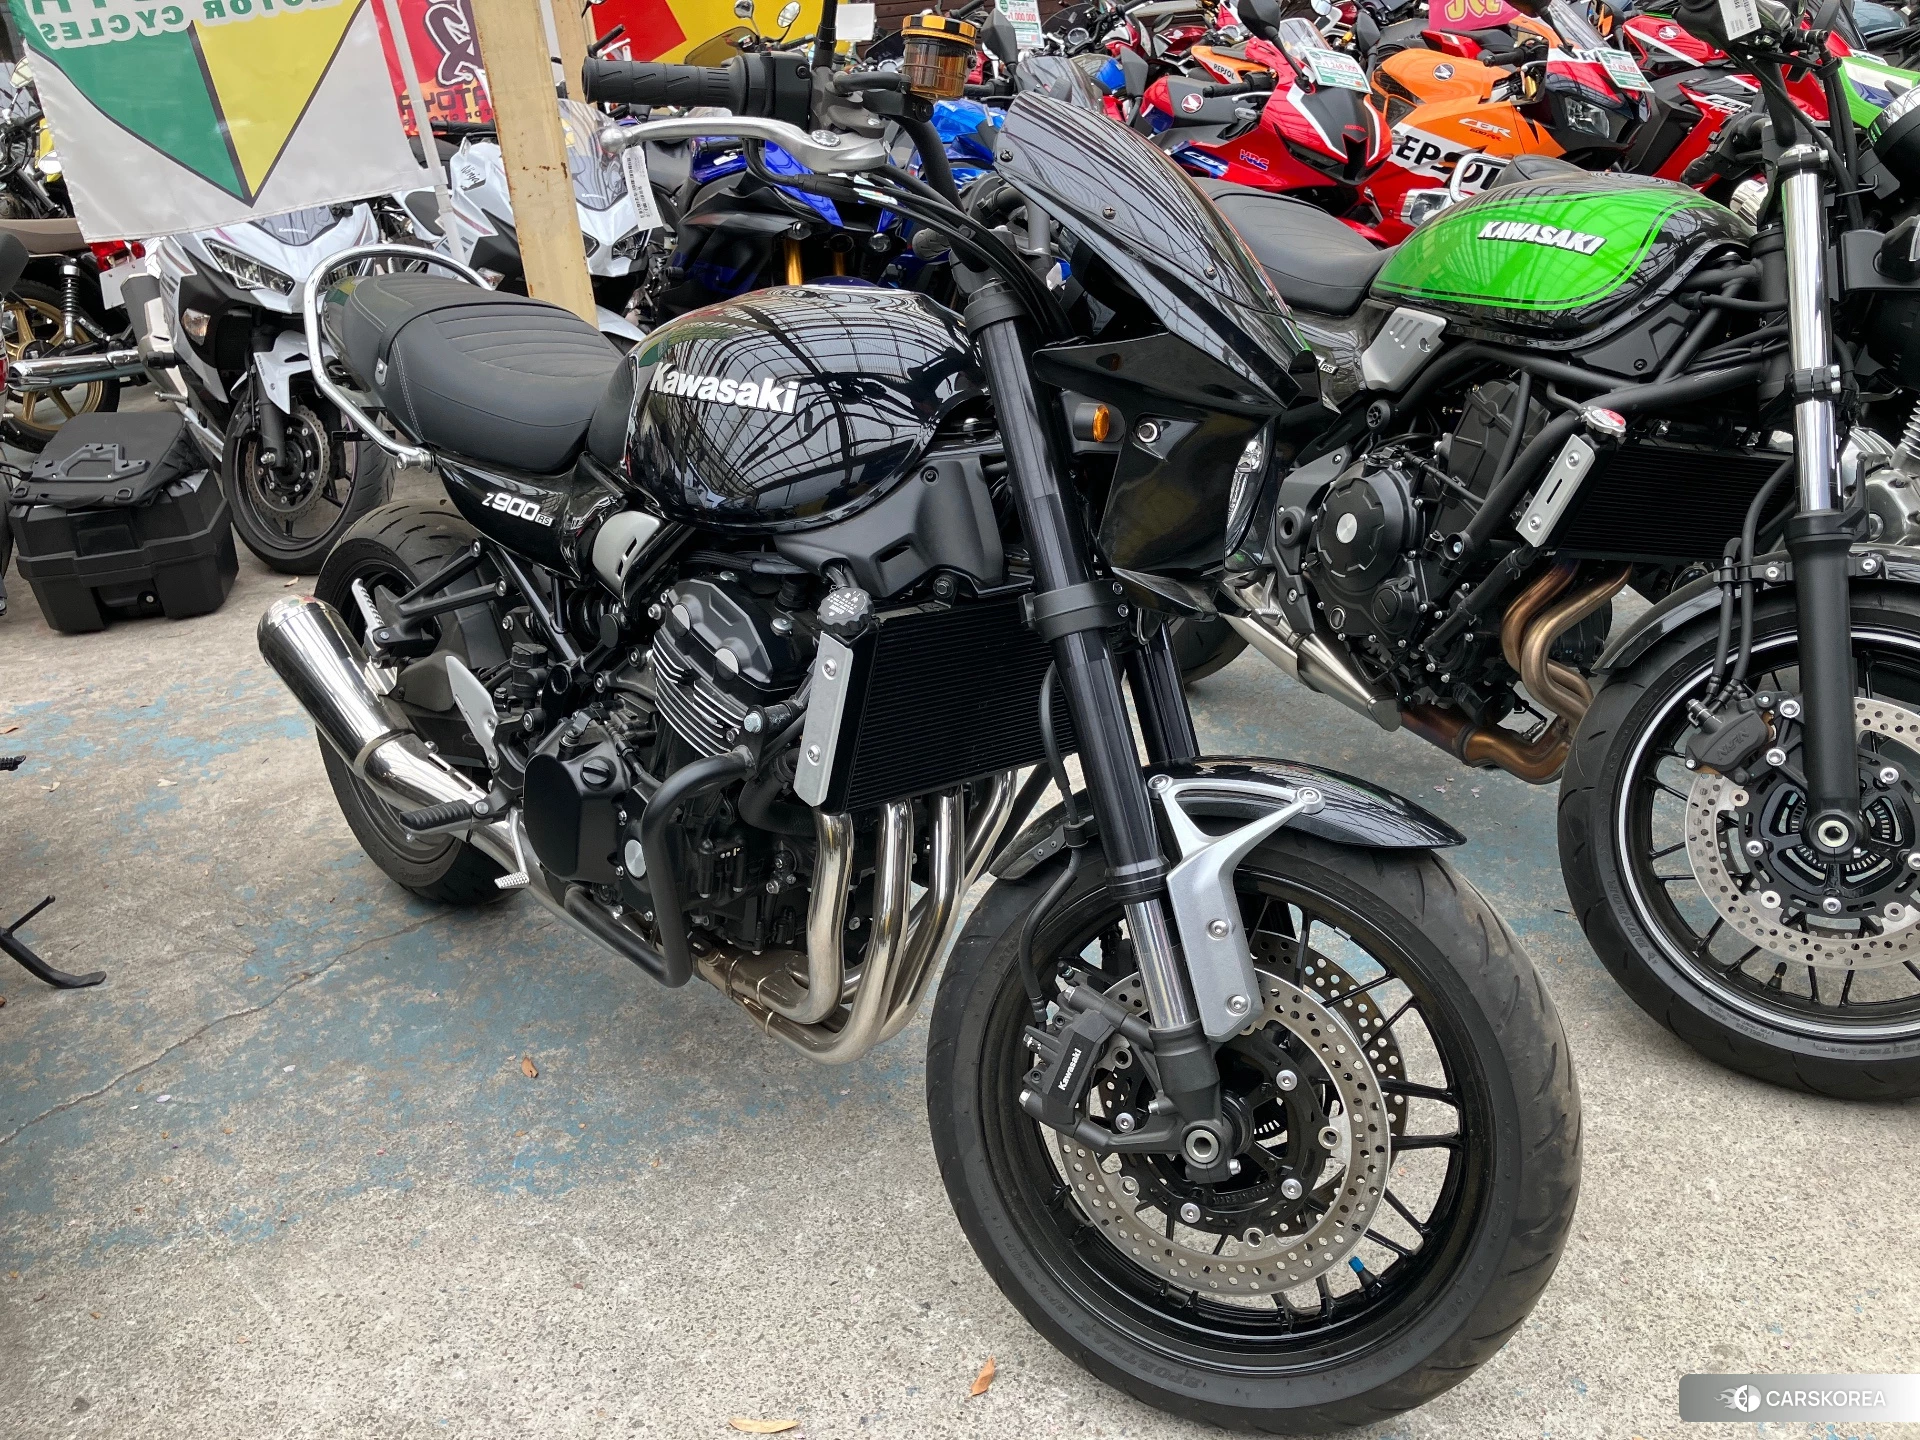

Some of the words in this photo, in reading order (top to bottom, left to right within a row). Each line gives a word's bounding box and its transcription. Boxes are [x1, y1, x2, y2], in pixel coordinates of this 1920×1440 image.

[1213, 63, 1235, 80] REPSOL
[1458, 117, 1512, 139] CBR
[1239, 149, 1269, 171] HRC
[1477, 221, 1608, 256] KAWASAKI
[650, 362, 799, 415] Kawasaki
[1058, 1047, 1082, 1091] Kawasaki
